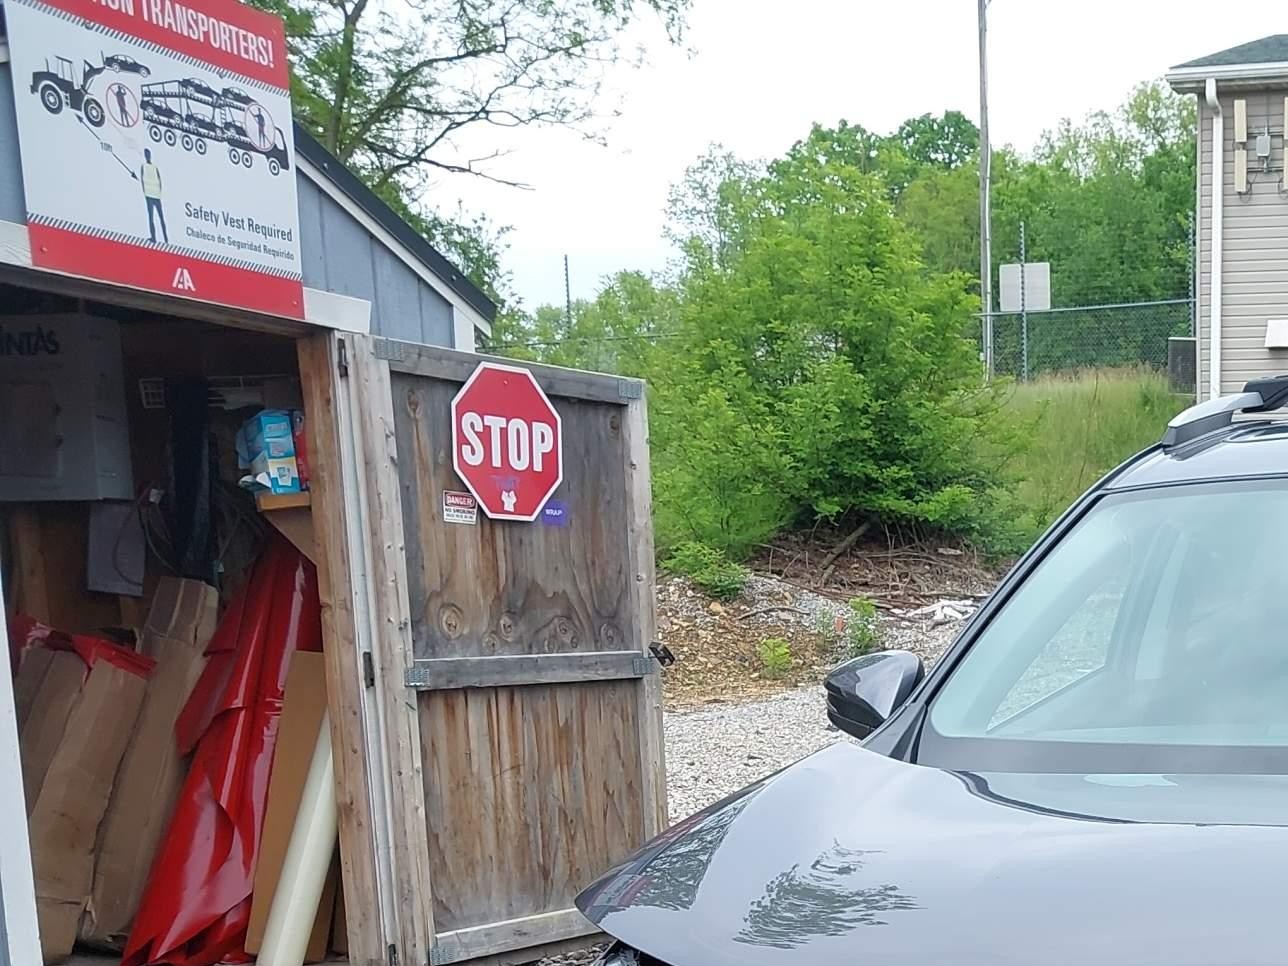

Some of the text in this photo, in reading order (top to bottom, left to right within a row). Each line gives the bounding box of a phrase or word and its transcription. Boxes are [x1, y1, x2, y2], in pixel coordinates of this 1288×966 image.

[141, 0, 275, 68] TRANSPORTERS!
[185, 202, 293, 242] Safety Vest Required
[186, 226, 215, 242] Chaleco
[217, 234, 226, 245] de
[227, 235, 261, 253] Seguridad
[461, 412, 554, 472] STOP
[446, 495, 473, 506] DANGER
